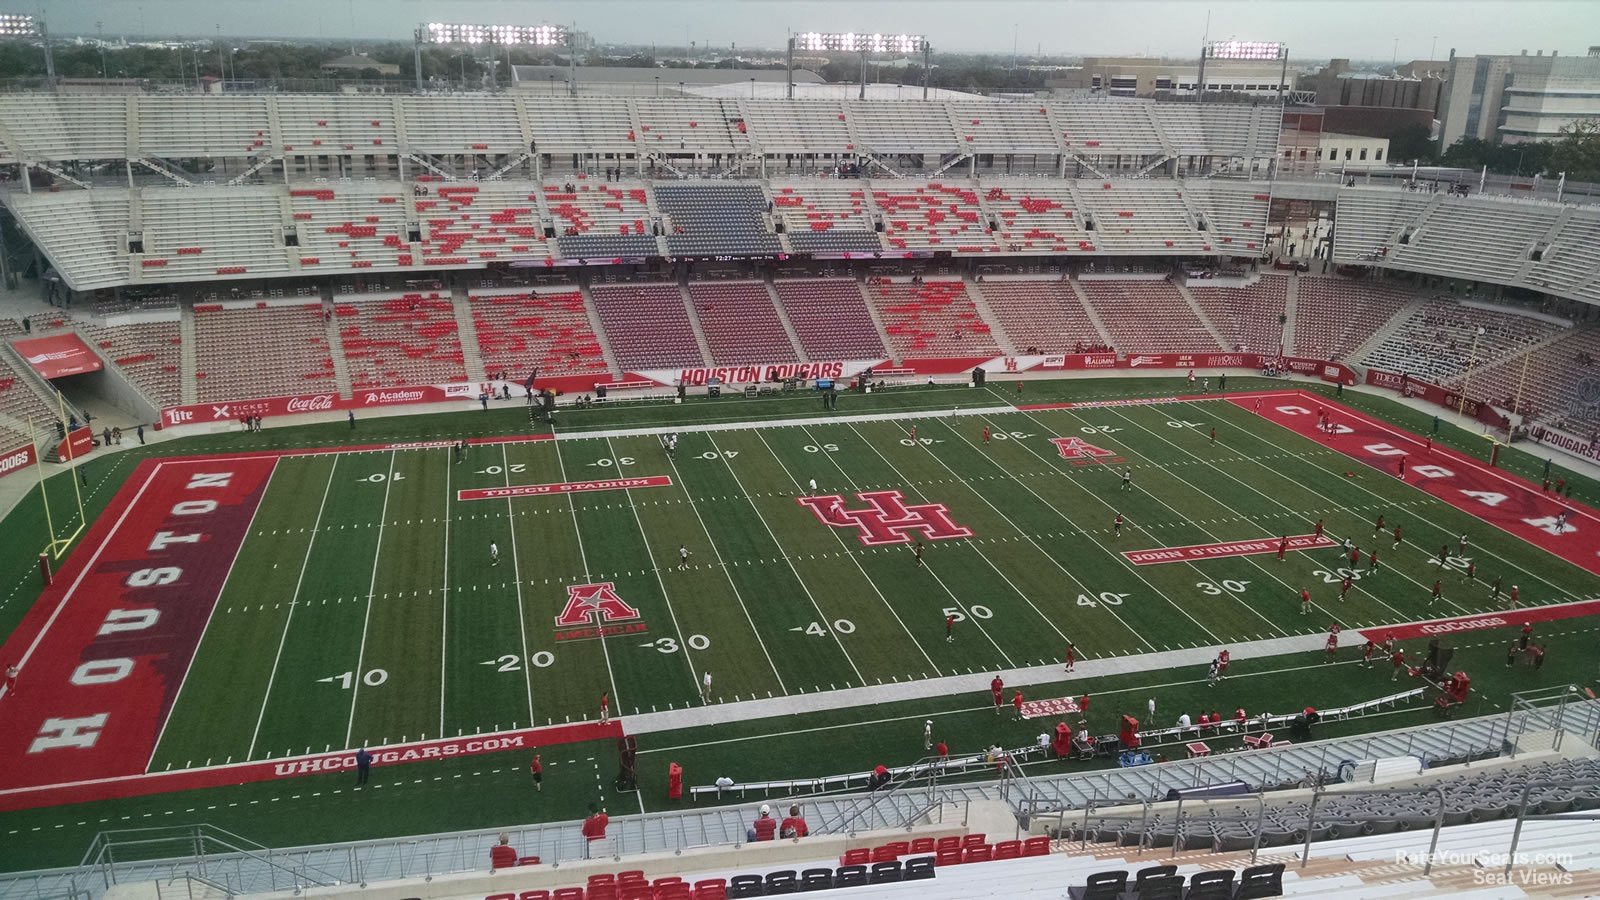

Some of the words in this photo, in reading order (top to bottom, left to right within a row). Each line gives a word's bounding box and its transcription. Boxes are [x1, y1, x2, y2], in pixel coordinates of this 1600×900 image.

[681, 366, 761, 385] HOUSTON
[765, 362, 843, 382] COUGARS
[379, 390, 424, 400] Academy
[233, 402, 270, 410] TICKET
[166, 408, 193, 424] Lite
[482, 485, 551, 497] TDECU
[559, 478, 649, 492] STADIUM
[1131, 550, 1184, 562] JOHN
[1272, 537, 1333, 549] FIELD
[26, 472, 234, 754] HOUSTON
